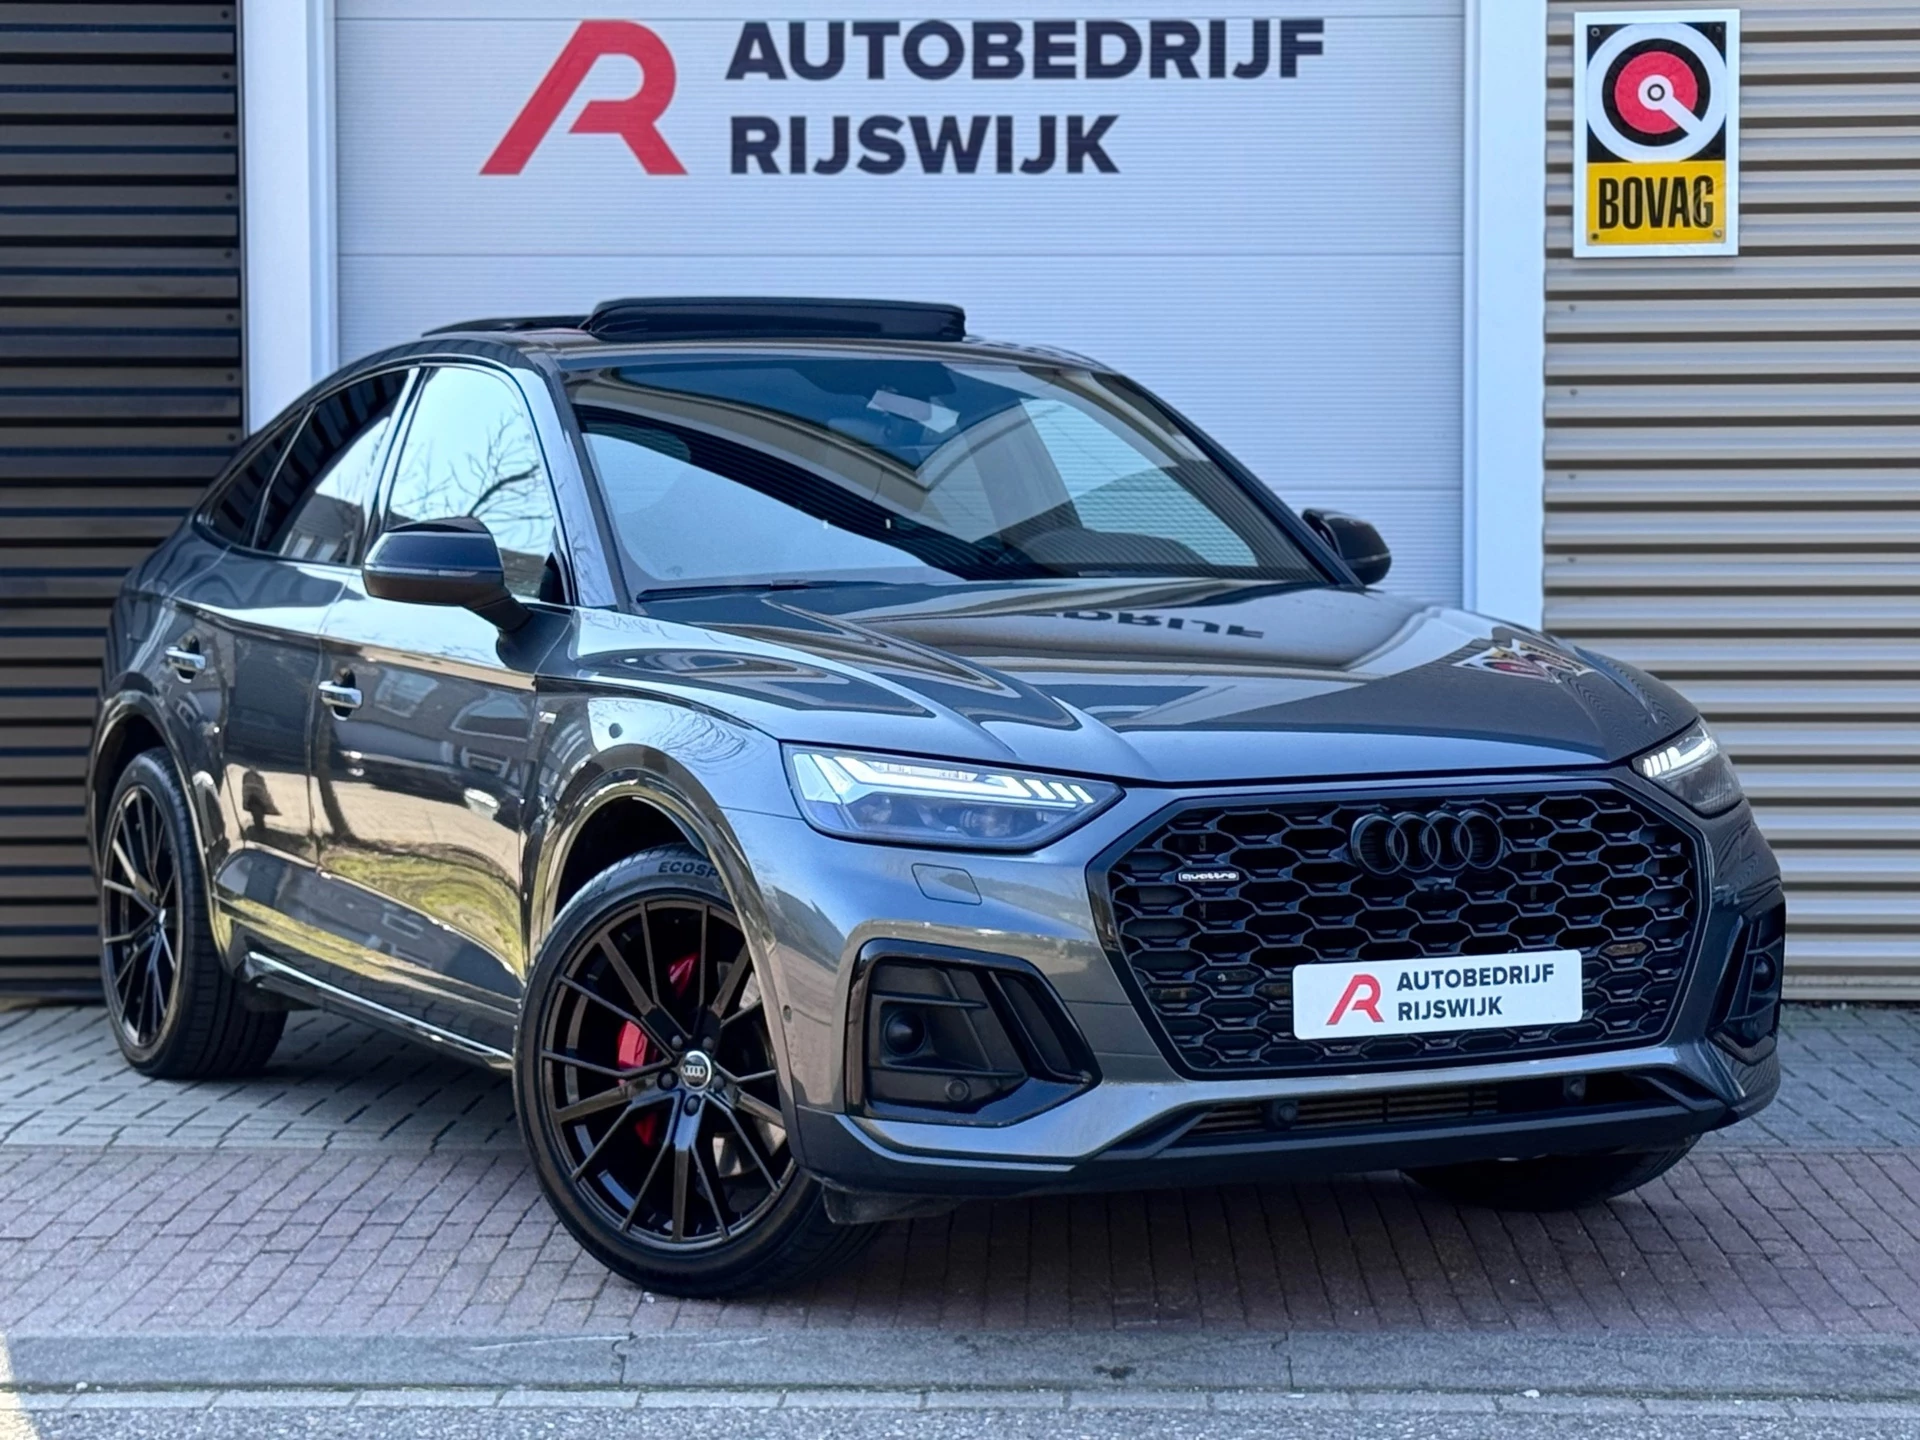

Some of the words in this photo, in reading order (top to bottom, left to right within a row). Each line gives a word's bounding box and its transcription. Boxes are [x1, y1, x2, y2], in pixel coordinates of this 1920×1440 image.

[726, 18, 1324, 80] AUTOBEDRIJF
[732, 115, 1119, 175] RIJSWIJK
[1599, 175, 1714, 229] BOVAG
[1181, 871, 1237, 881] quattro
[1396, 963, 1555, 992] AUTOBEDRIJF
[1398, 996, 1503, 1021] RIJSWIJK
